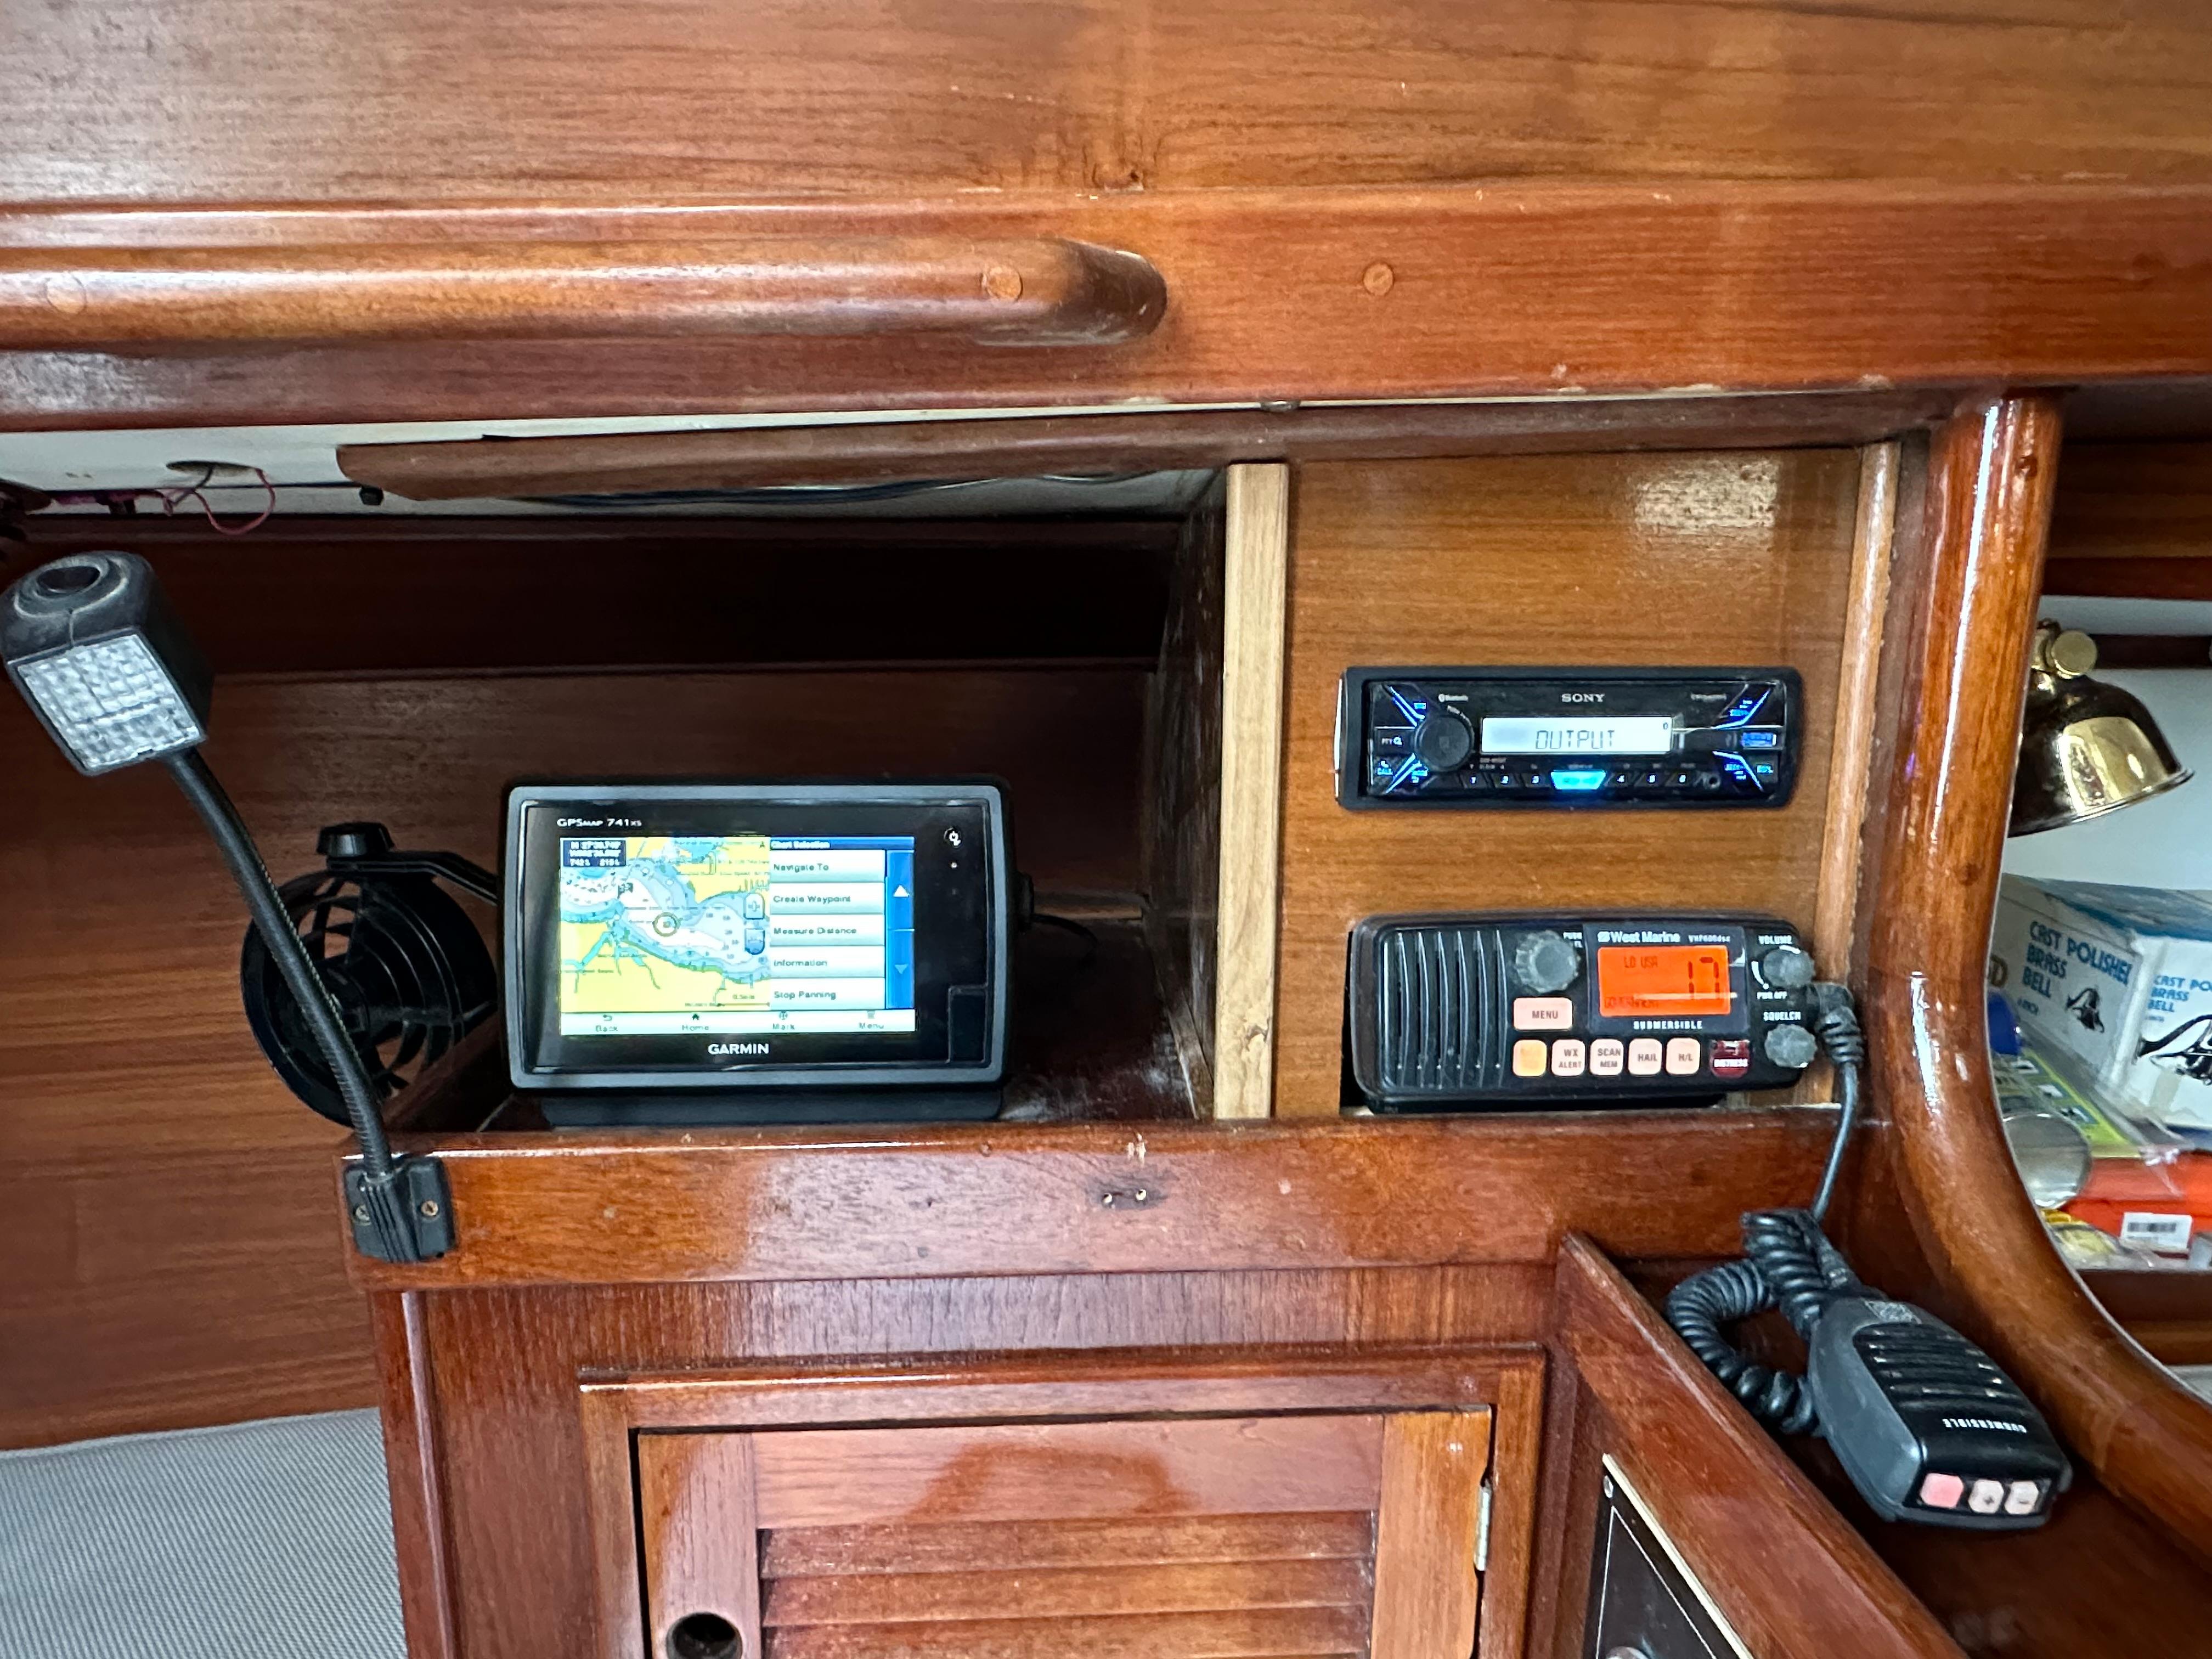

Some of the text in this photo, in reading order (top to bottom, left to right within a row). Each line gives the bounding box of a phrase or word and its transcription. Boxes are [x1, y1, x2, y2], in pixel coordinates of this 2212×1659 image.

[1561, 693, 1605, 702] SONY
[1536, 730, 1615, 749] OUTPUT
[774, 863, 814, 873] Navigate
[807, 895, 851, 904] Waypoint
[1610, 931, 1681, 943] West Marine
[1758, 935, 1793, 945] VOLUME
[2030, 922, 2062, 950] CAST
[1640, 956, 1658, 968] USA
[2027, 943, 2067, 979] BRASS
[1688, 957, 1720, 1001] 17
[2022, 966, 2051, 998] BELL
[2153, 975, 2186, 988] CAST
[774, 991, 836, 1000] Stop Panning
[2151, 987, 2190, 1002] BRASS
[2147, 1000, 2175, 1013] BELL
[1532, 1010, 1558, 1019] MENU
[1763, 1012, 1802, 1021] SQUELCH
[1633, 1020, 1702, 1030] SUBMERSIBLE
[708, 1043, 769, 1054] GARMIN
[1564, 1048, 1578, 1057] WX
[1597, 1048, 1621, 1056] SCAN
[1637, 1053, 1657, 1062] HAIL
[1678, 1053, 1693, 1062] H/L
